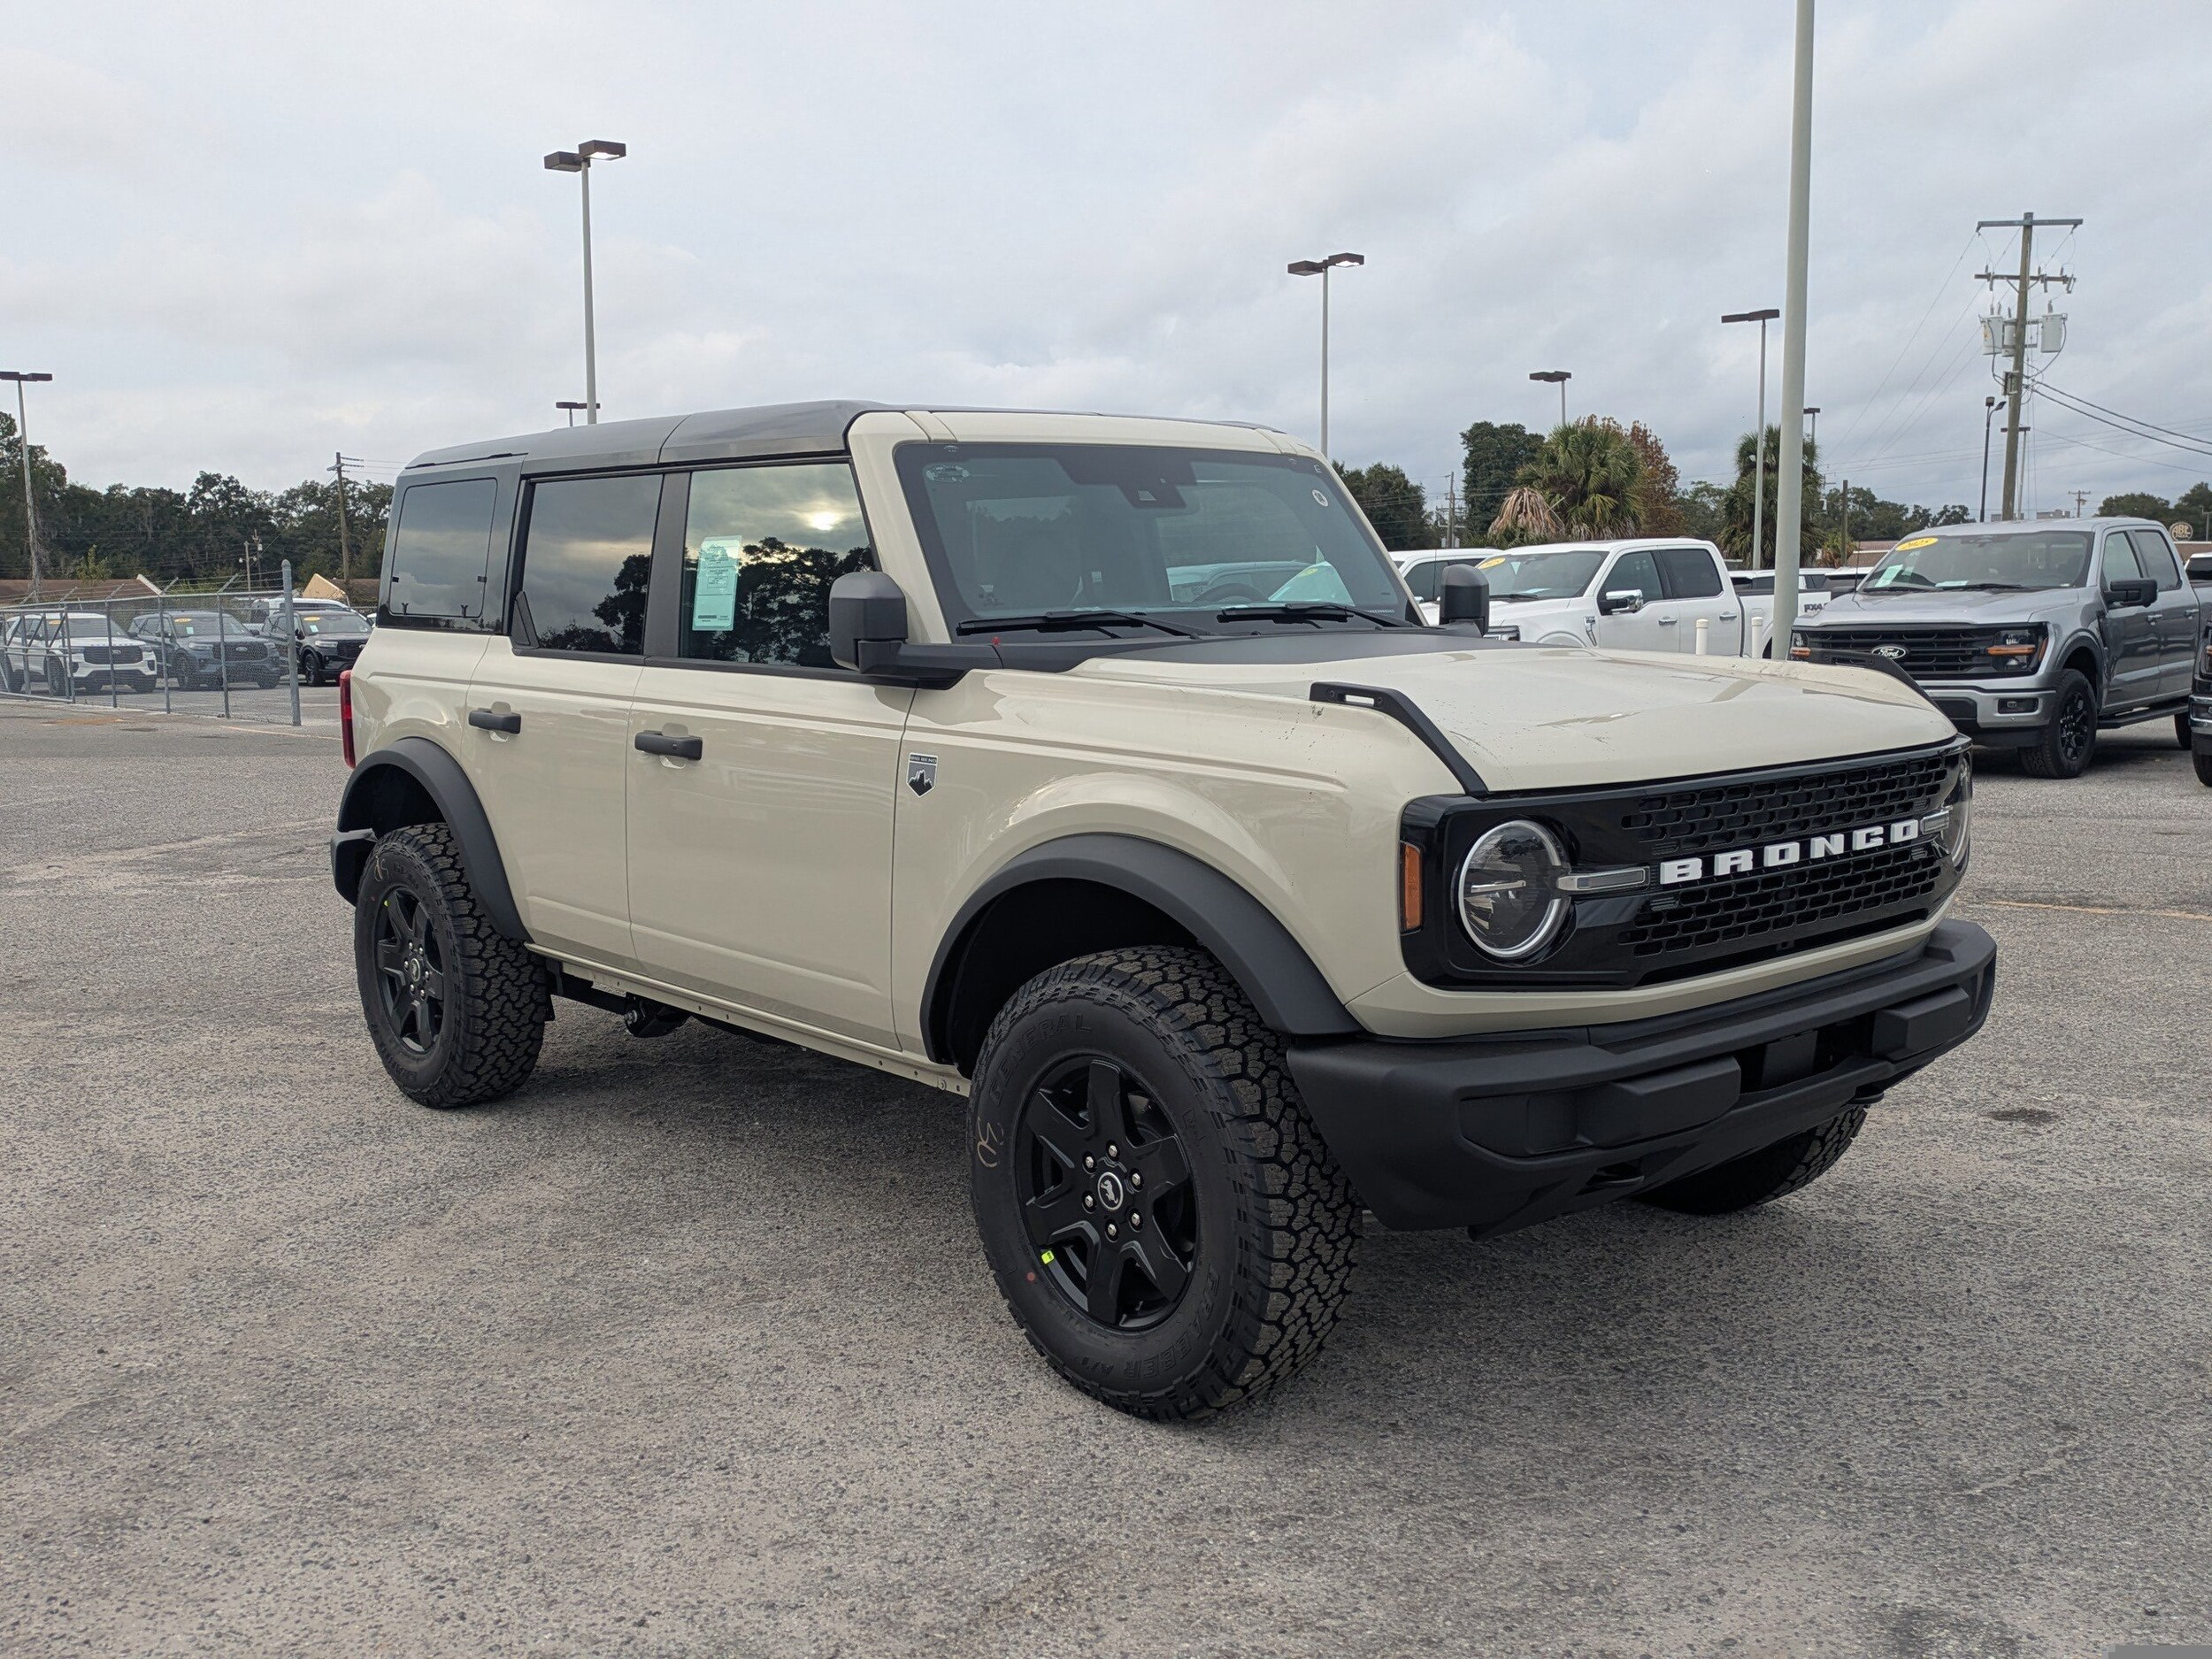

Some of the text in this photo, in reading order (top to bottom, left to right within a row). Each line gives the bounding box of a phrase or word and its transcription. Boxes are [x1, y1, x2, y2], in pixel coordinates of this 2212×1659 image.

[1878, 648, 1900, 657] Ford
[1660, 819, 1919, 885] BRONCO
[988, 1012, 1094, 1108] GENERAL
